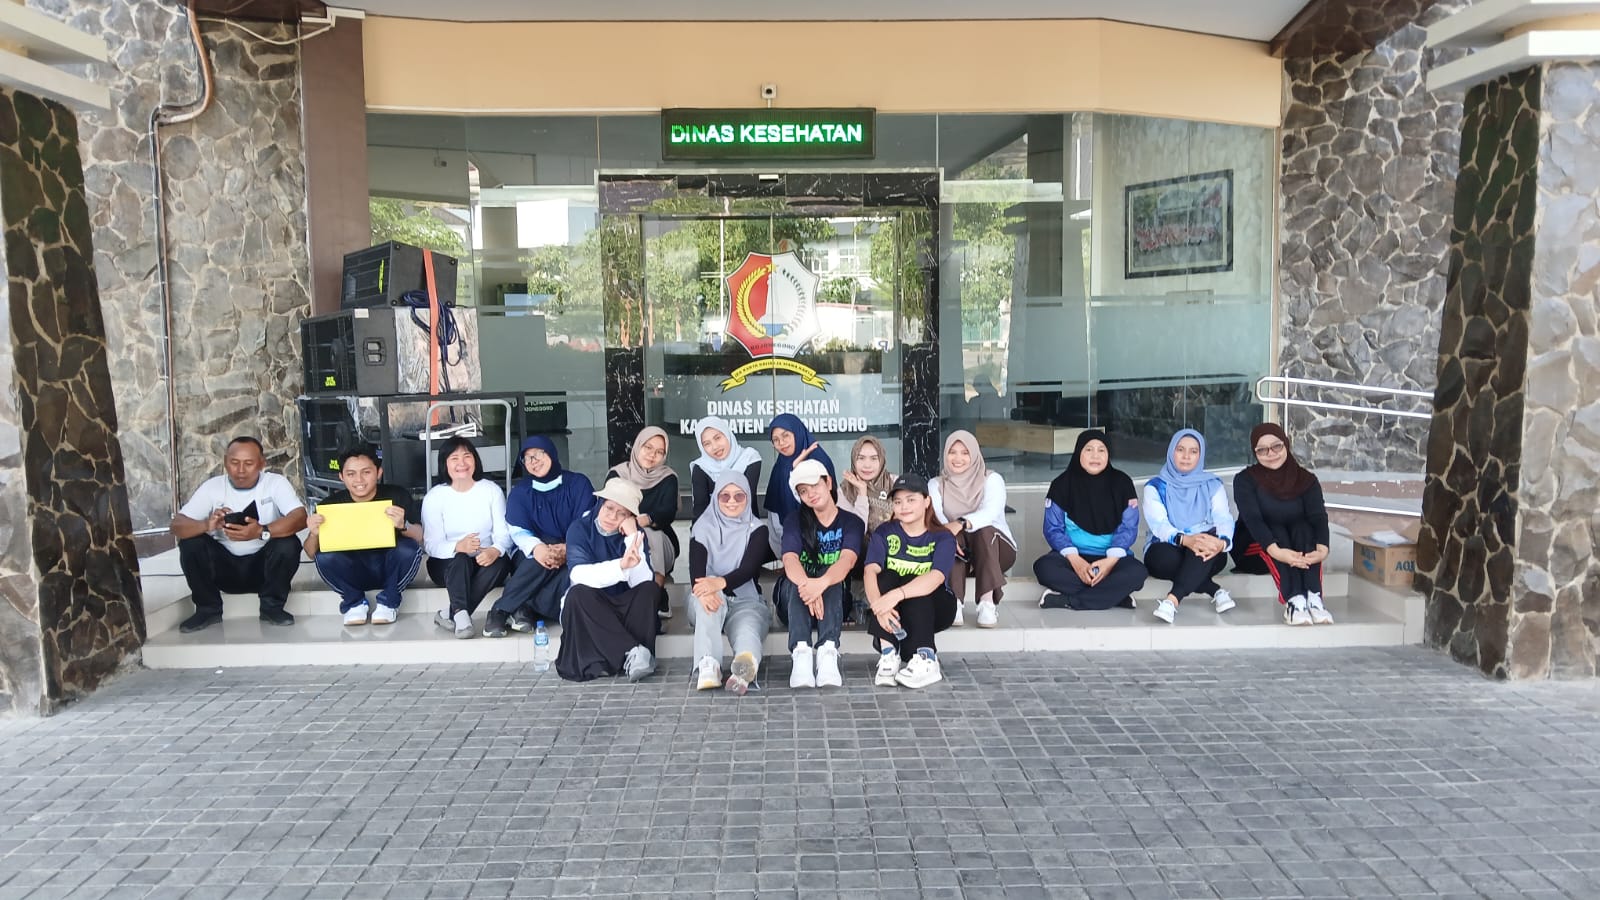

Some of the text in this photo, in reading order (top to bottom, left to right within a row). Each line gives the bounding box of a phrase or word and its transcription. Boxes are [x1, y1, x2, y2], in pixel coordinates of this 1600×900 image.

[671, 124, 862, 143] DINAS KESEHATAN
[707, 399, 840, 416] DINAS KESEHATAN
